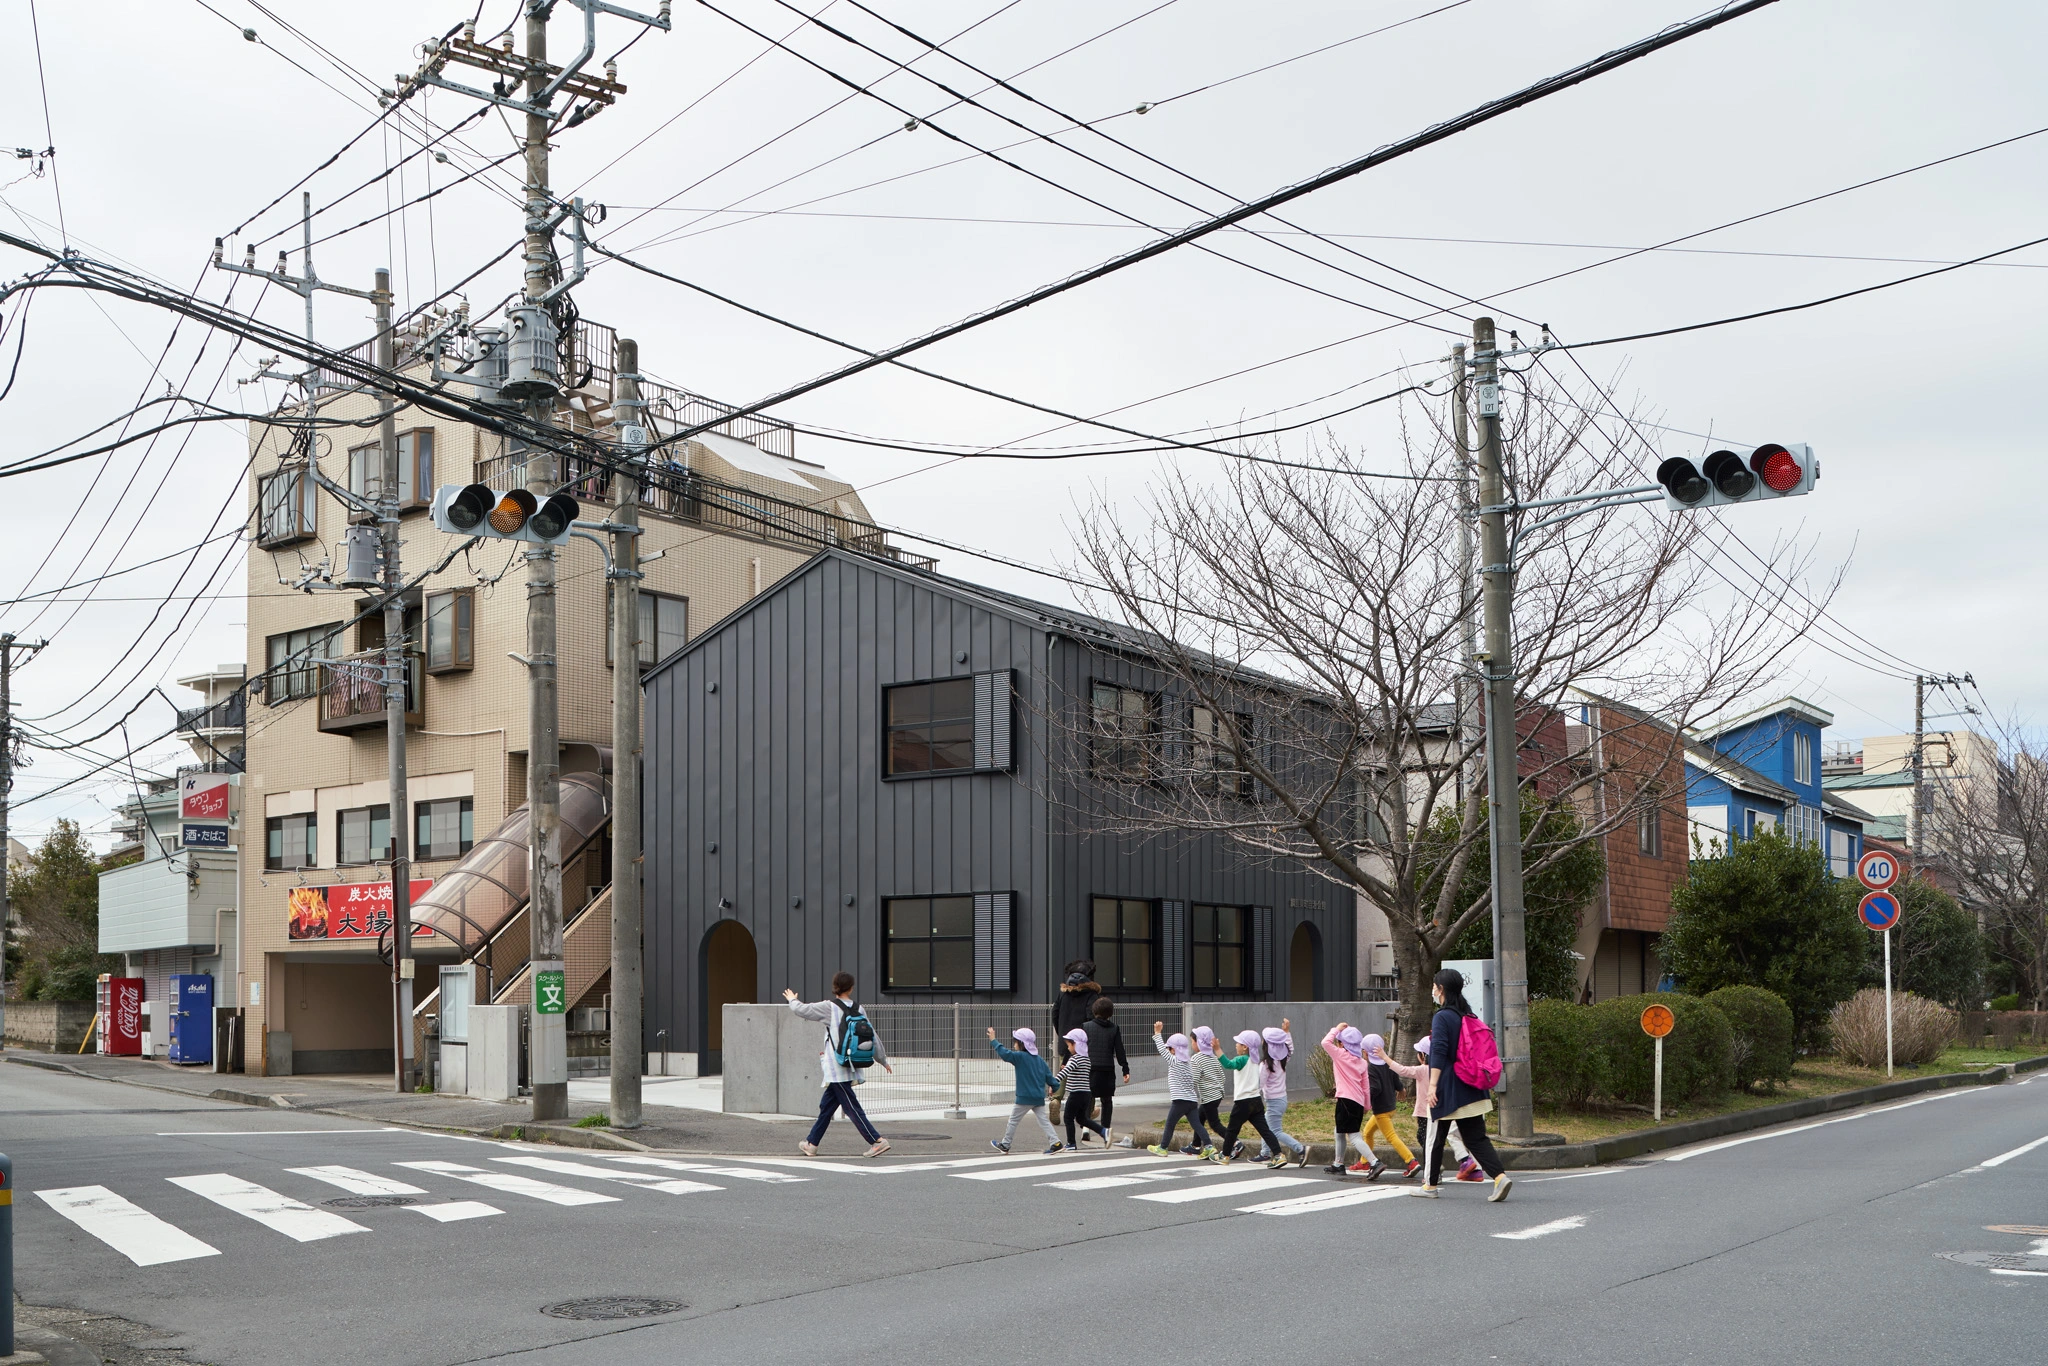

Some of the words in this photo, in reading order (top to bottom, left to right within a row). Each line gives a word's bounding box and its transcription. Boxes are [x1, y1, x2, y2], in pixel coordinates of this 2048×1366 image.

[190, 793, 209, 808] タウン
[201, 798, 224, 815] ショップ
[185, 829, 226, 842] 酒・たばこ
[1867, 862, 1890, 879] 40
